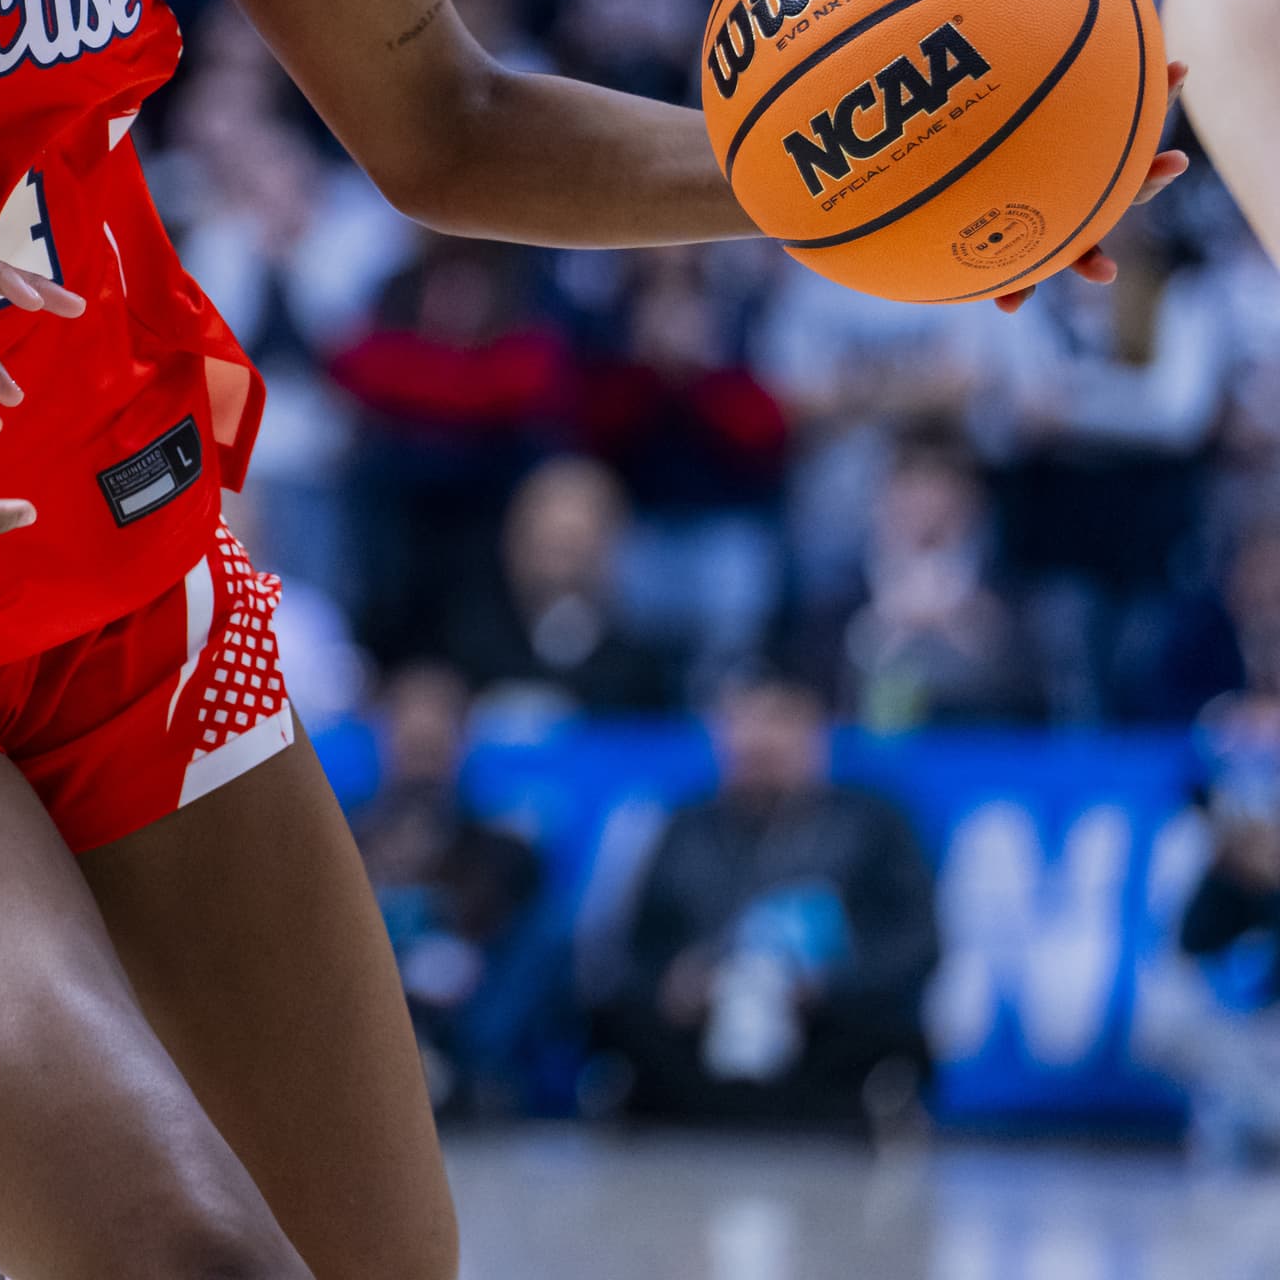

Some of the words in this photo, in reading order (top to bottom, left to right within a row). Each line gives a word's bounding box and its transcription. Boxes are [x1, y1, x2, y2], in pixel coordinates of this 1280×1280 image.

[776, 19, 809, 52] EVO
[782, 20, 993, 197] NCAA
[821, 163, 890, 212] OFFICIAL
[891, 119, 947, 161] GAME
[949, 83, 1001, 120] BALL
[177, 445, 193, 467] L
